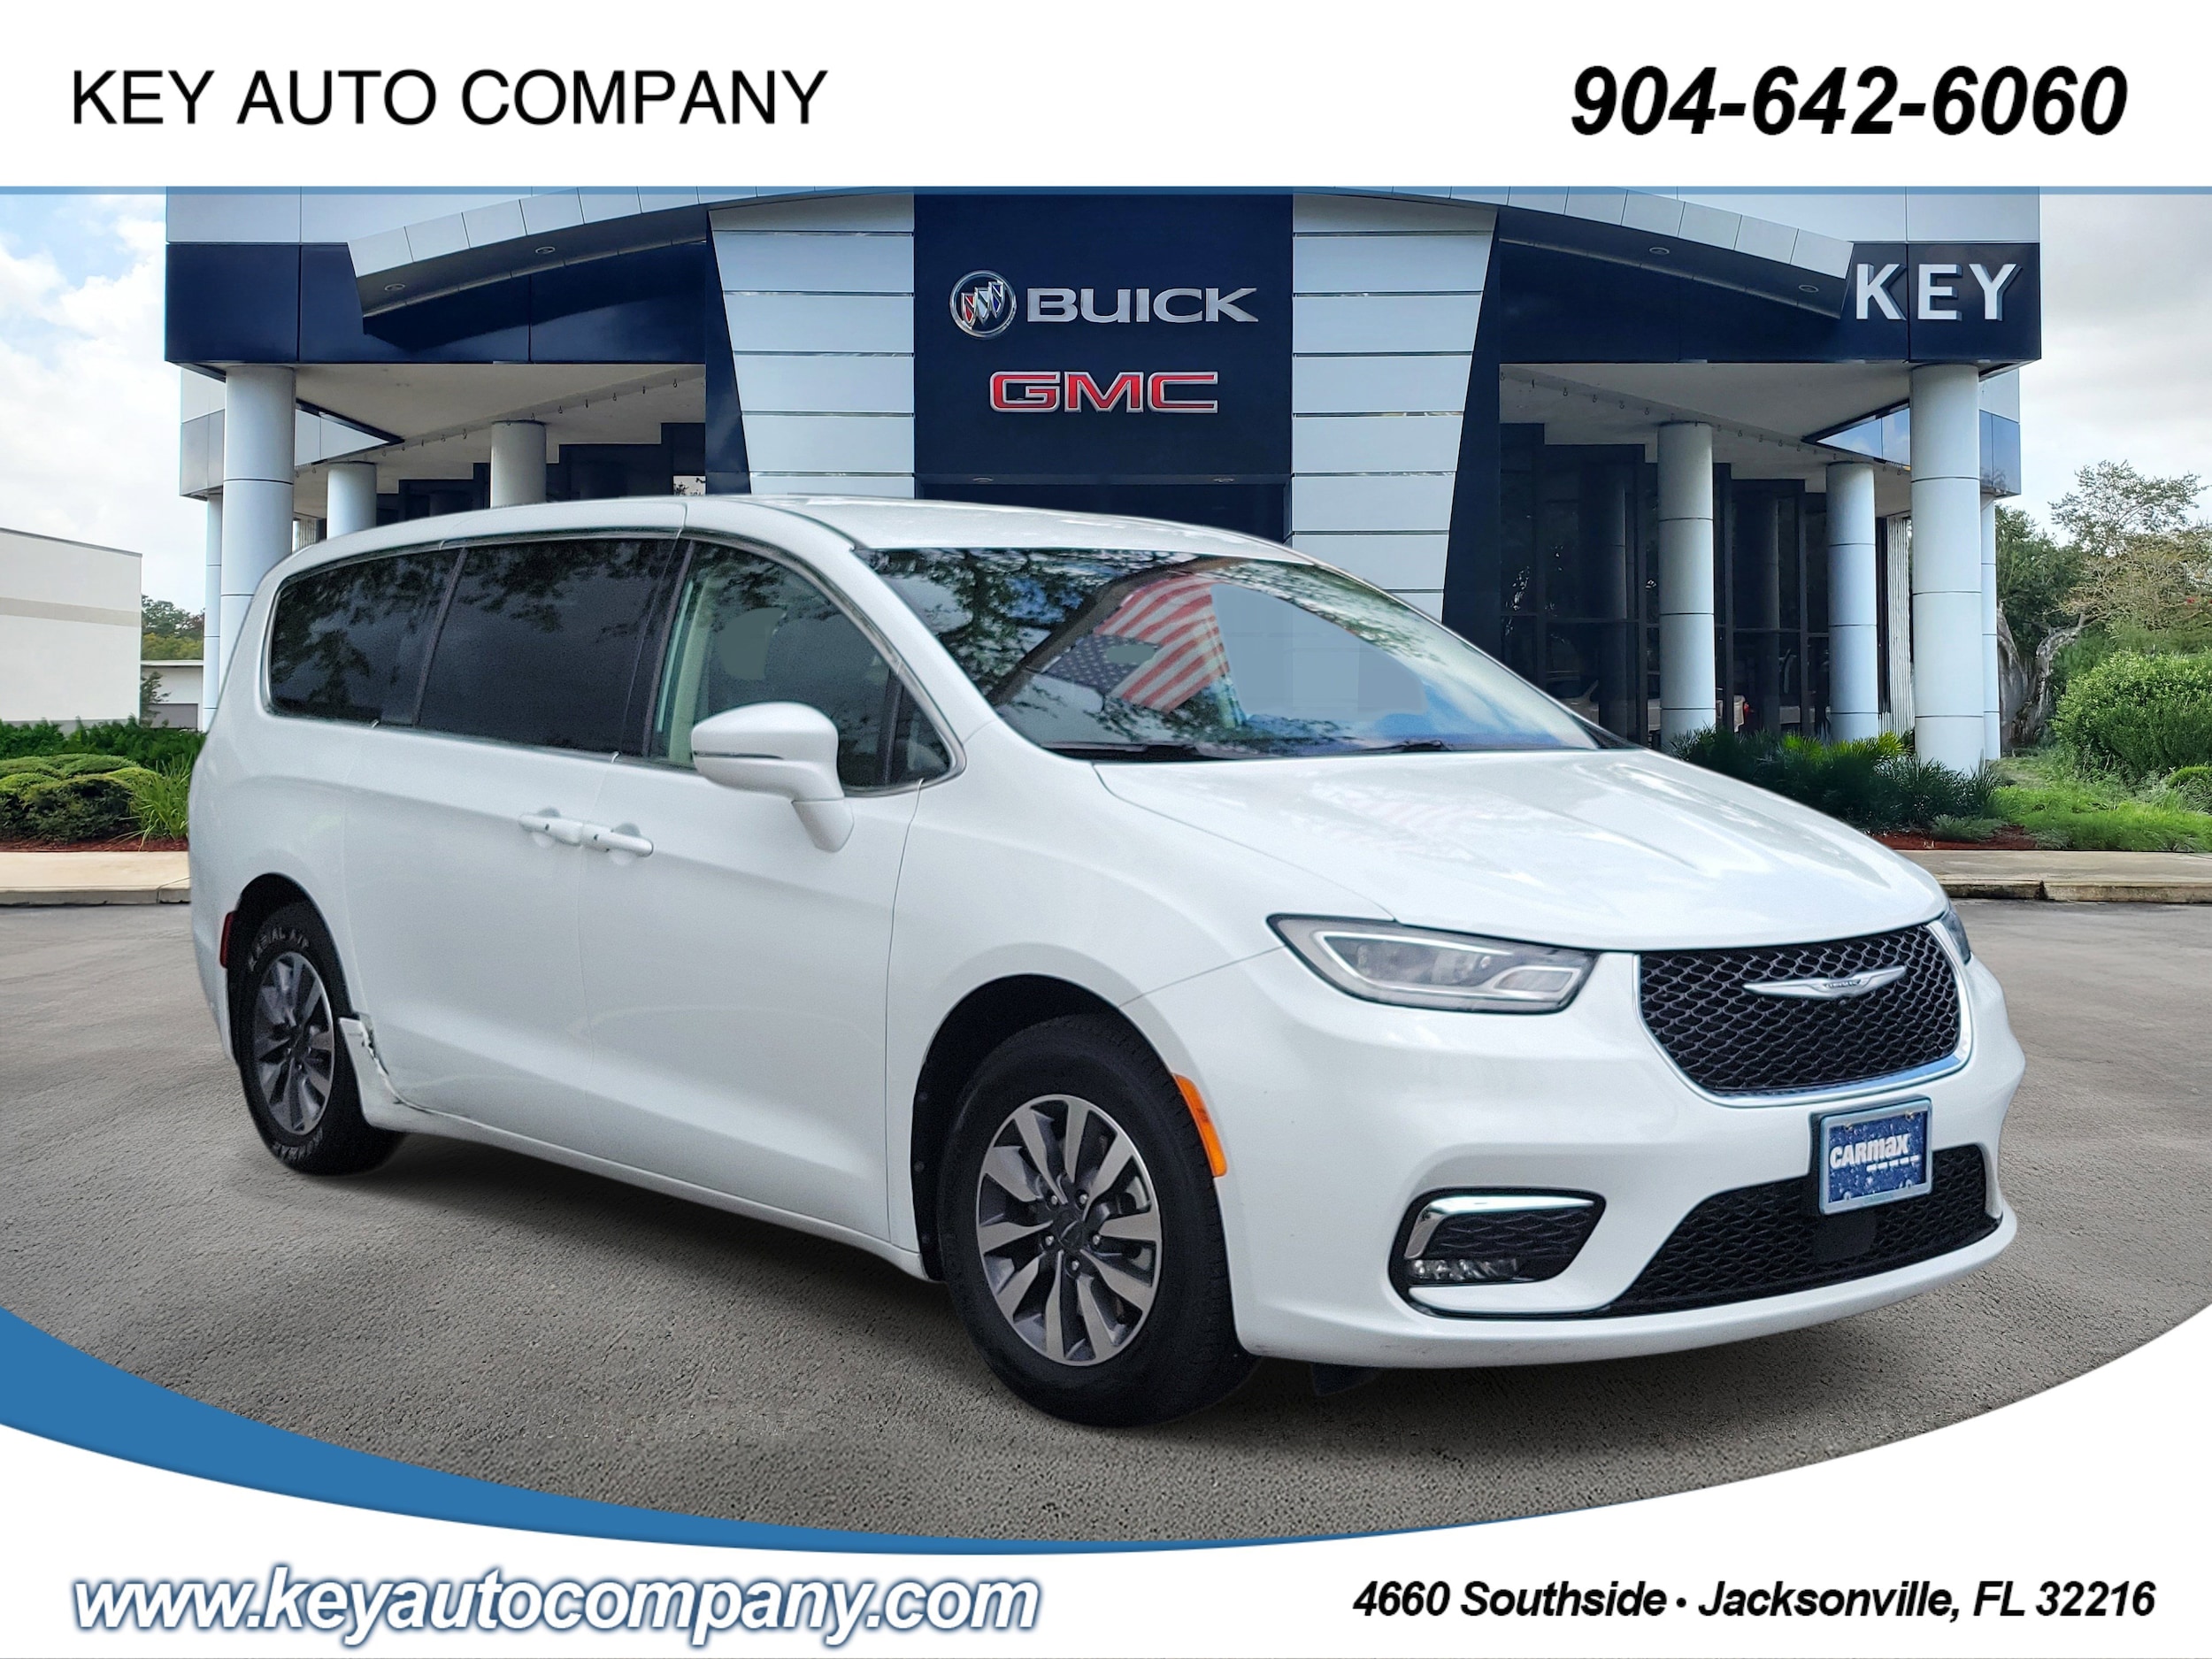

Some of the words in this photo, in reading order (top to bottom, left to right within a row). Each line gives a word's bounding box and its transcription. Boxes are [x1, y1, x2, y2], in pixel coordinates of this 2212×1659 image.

[1026, 287, 1259, 324] BUICK
[1855, 263, 2022, 320] KEY
[989, 370, 1218, 414] GMC
